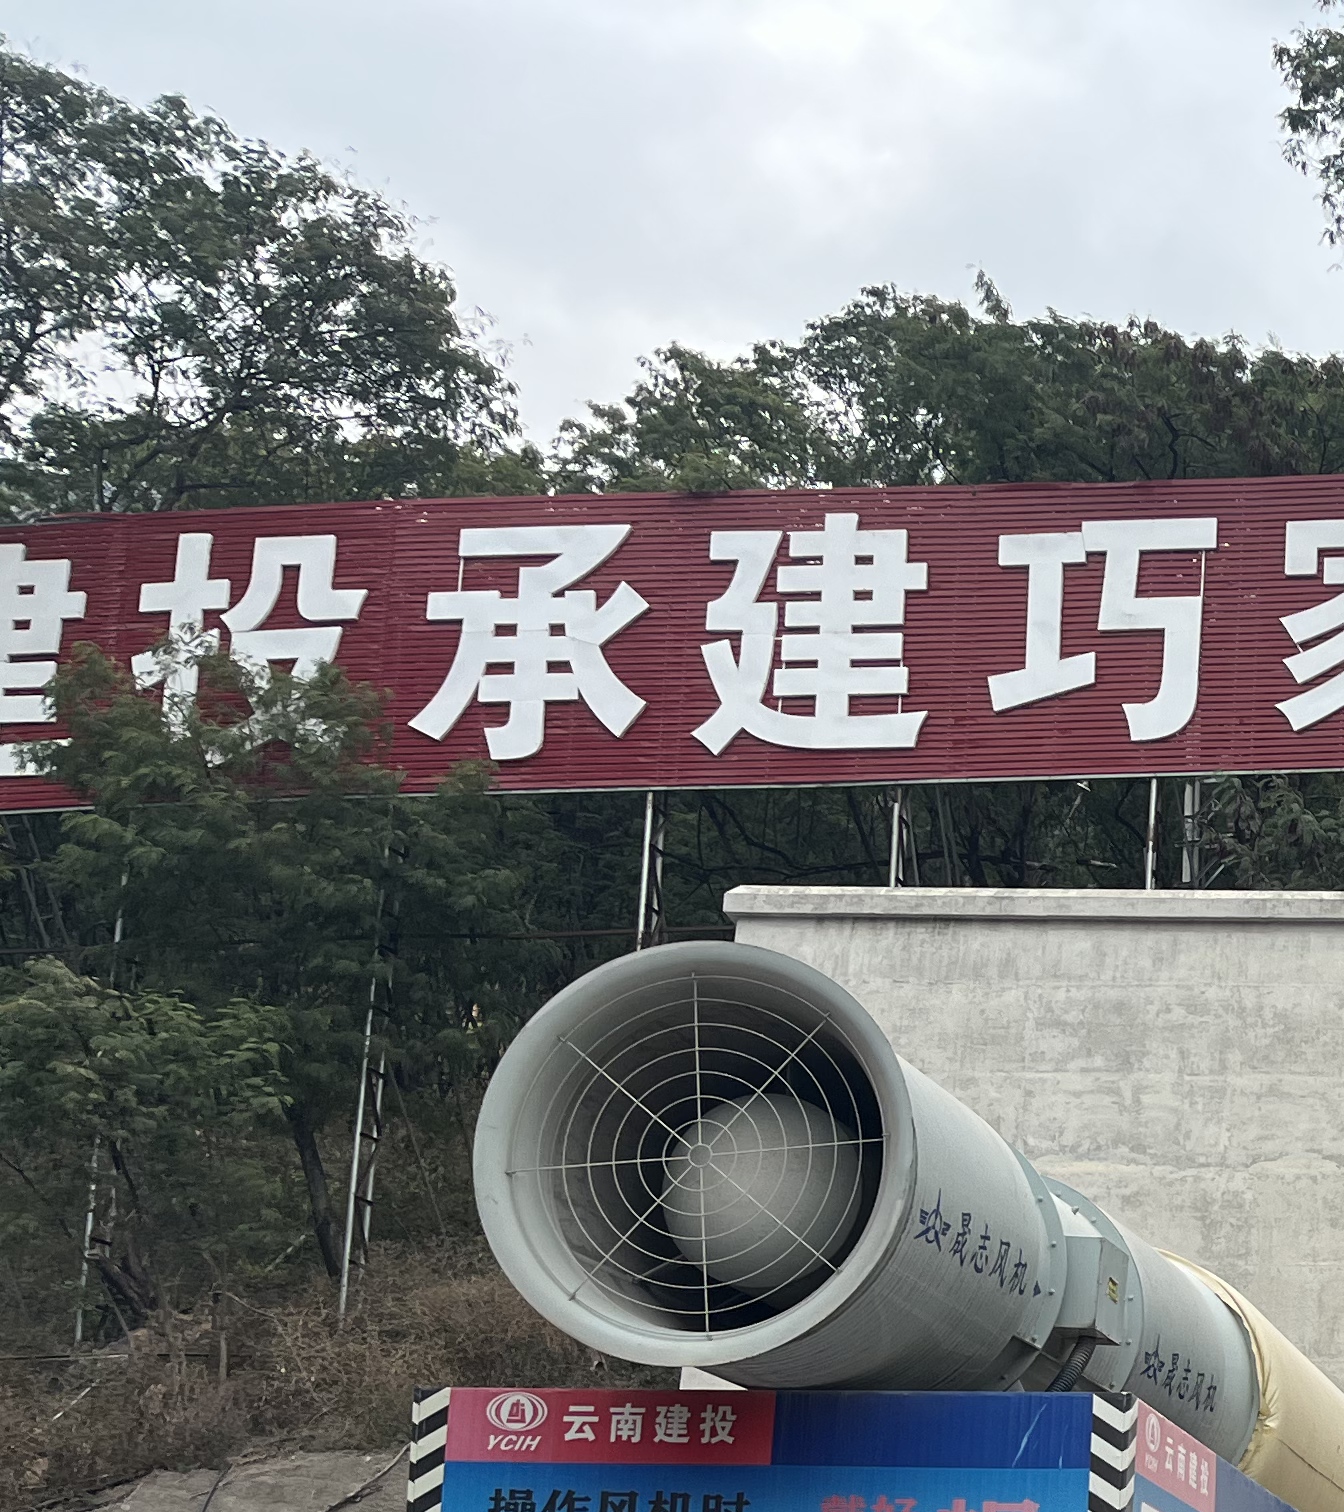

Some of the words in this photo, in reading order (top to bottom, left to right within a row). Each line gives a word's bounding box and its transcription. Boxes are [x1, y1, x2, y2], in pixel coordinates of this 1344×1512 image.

[562, 1402, 738, 1445] 云南建投
[486, 1434, 543, 1452] YCIH
